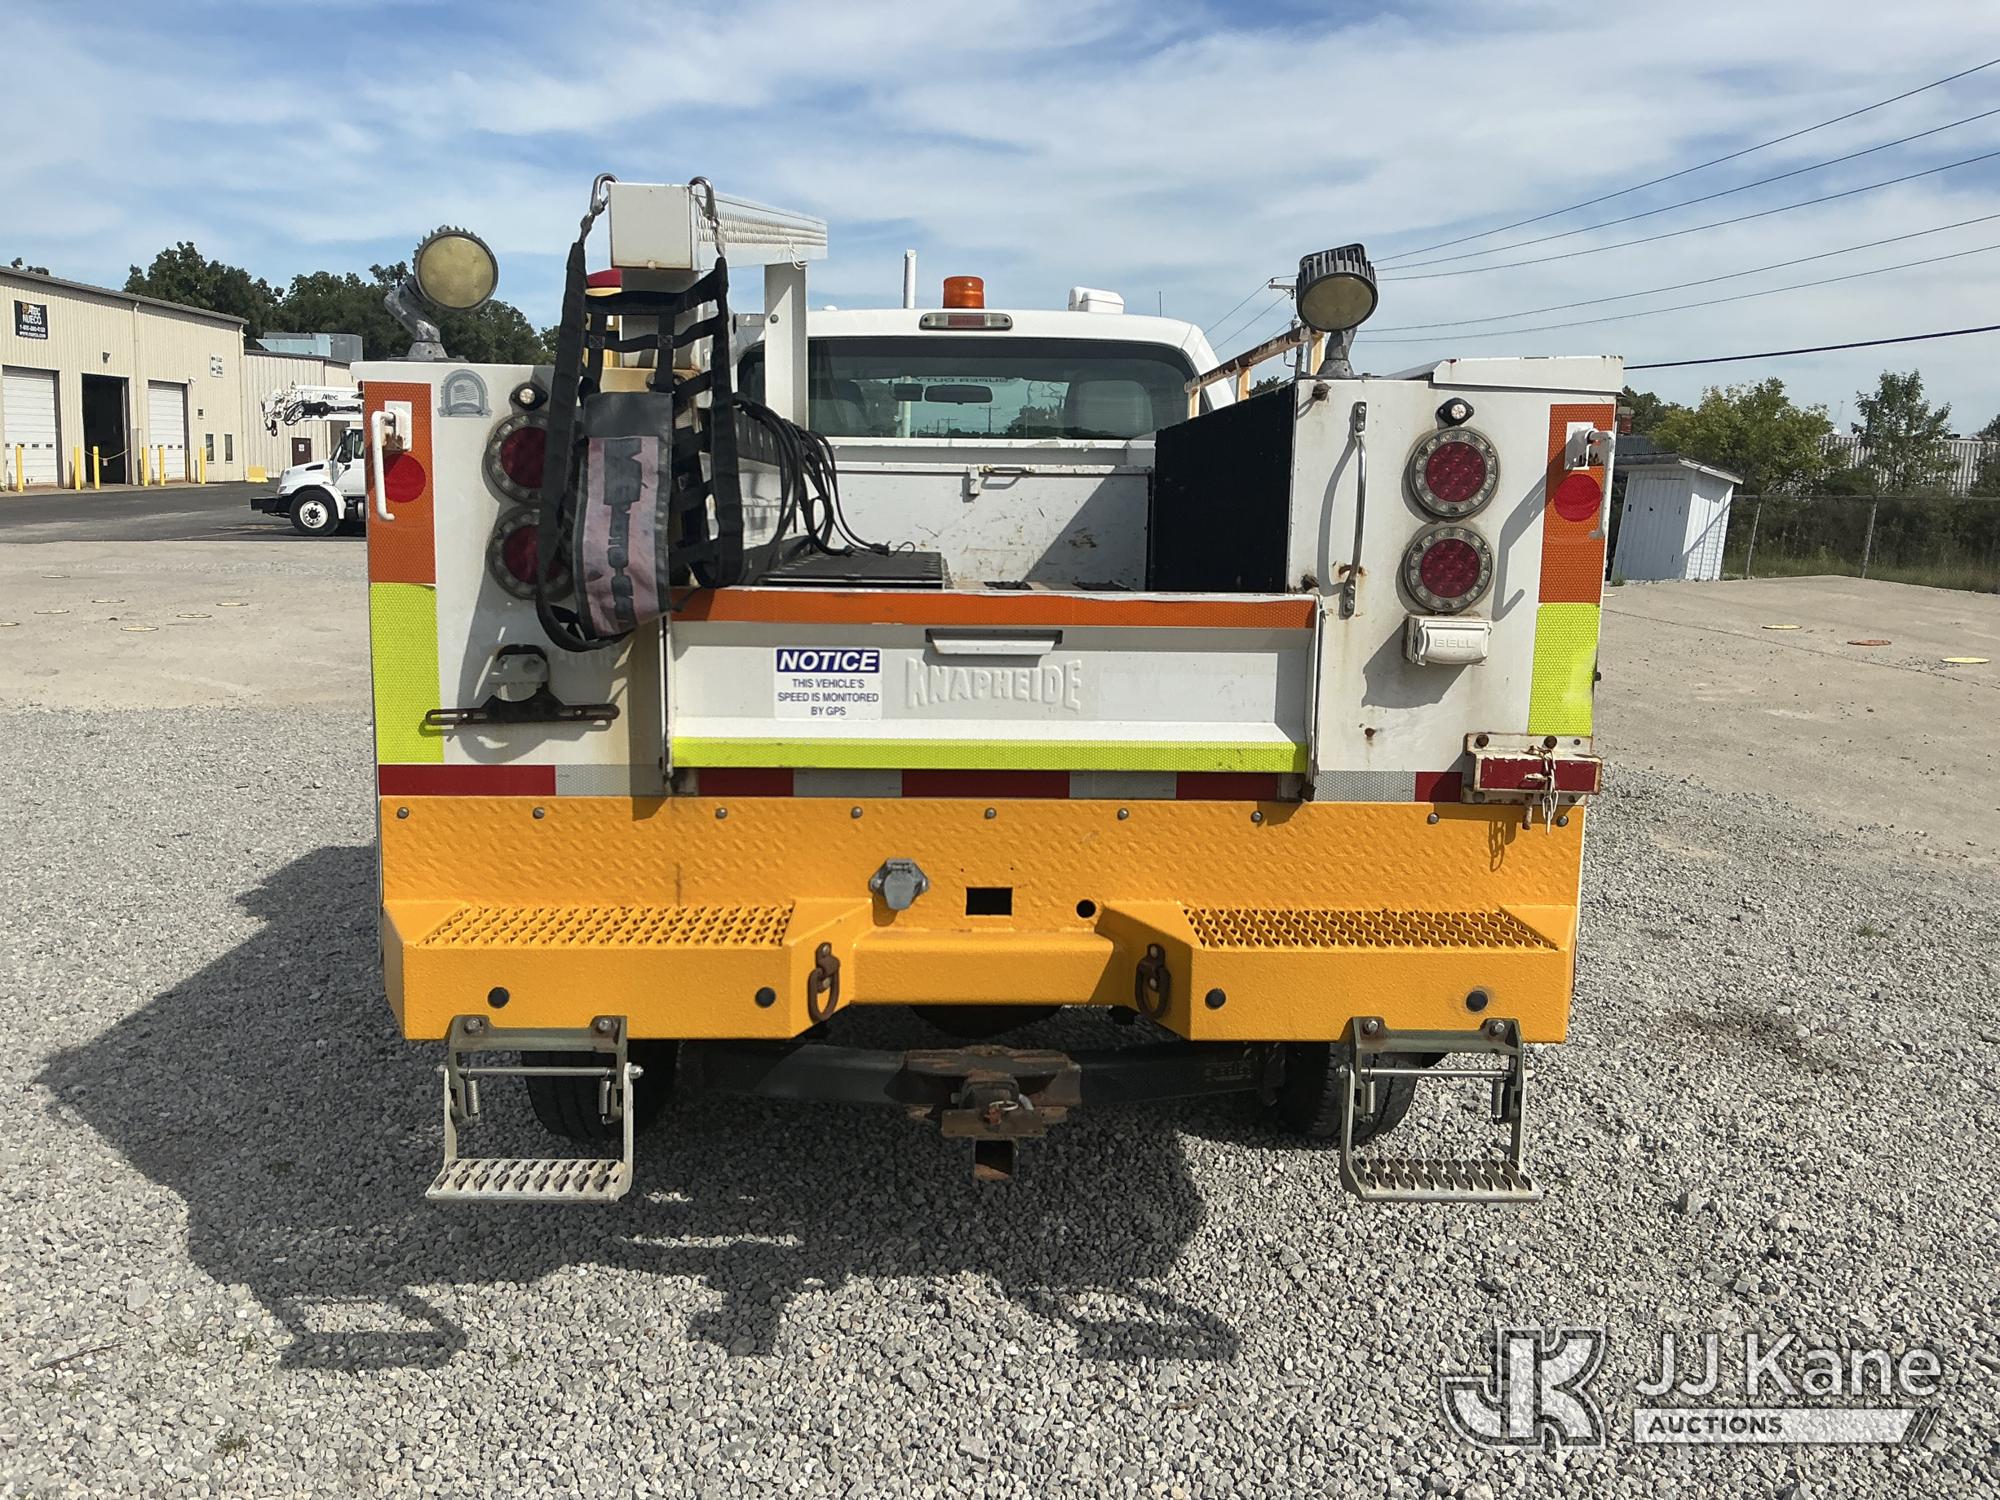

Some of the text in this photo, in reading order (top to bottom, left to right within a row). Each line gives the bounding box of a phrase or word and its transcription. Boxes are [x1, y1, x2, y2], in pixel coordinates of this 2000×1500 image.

[321, 393, 339, 401] Altec
[1434, 639, 1476, 649] BELL
[779, 651, 879, 671] NOTICE
[792, 678, 865, 689] THIS VEHICLE'S
[905, 656, 1083, 713] KNAPHEIDE
[777, 692, 879, 703] SPEED IS MONITORED
[811, 706, 847, 716] BY GPS
